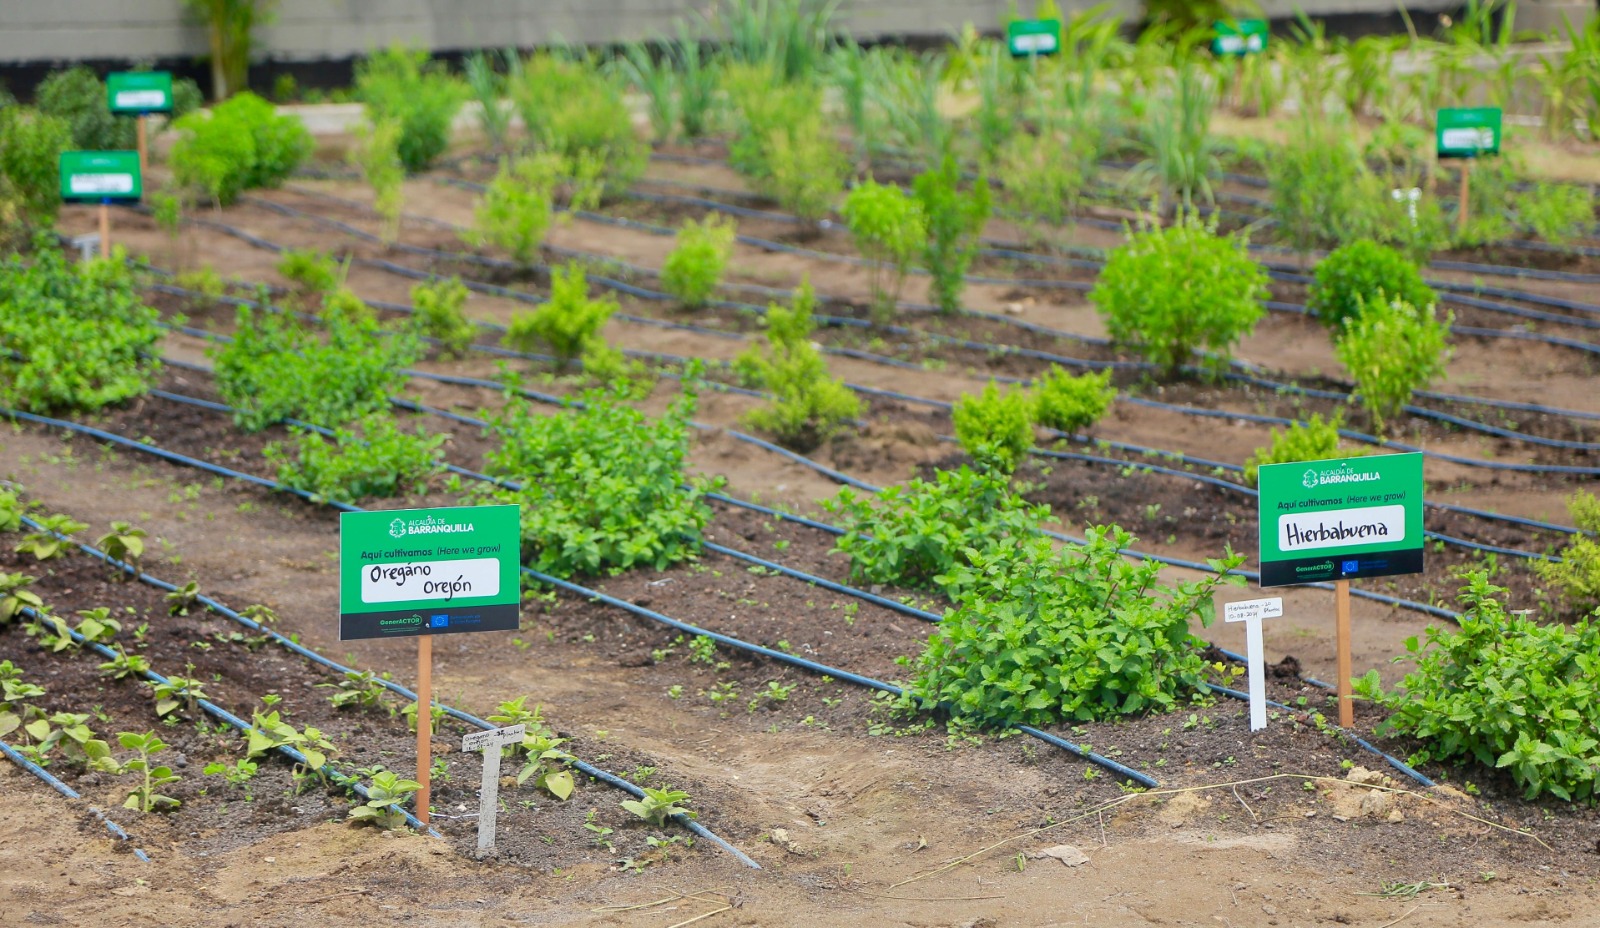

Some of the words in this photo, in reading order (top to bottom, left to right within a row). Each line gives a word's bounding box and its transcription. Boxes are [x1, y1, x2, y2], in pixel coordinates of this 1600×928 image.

[1320, 472, 1380, 485] BARRANQUILLA
[1277, 500, 1297, 511] Aquí
[1299, 497, 1343, 508] cultivamos
[1346, 494, 1368, 504] (Here
[1383, 491, 1406, 503] grow)
[408, 523, 474, 535] BARRANQUILLA
[1286, 520, 1388, 546] Hierbabuena
[361, 549, 382, 561] Aquí
[384, 548, 432, 559] cultivamos
[437, 546, 460, 556] (Here
[462, 546, 474, 554] we
[477, 544, 501, 555] grow)
[370, 562, 431, 587] Oregáno
